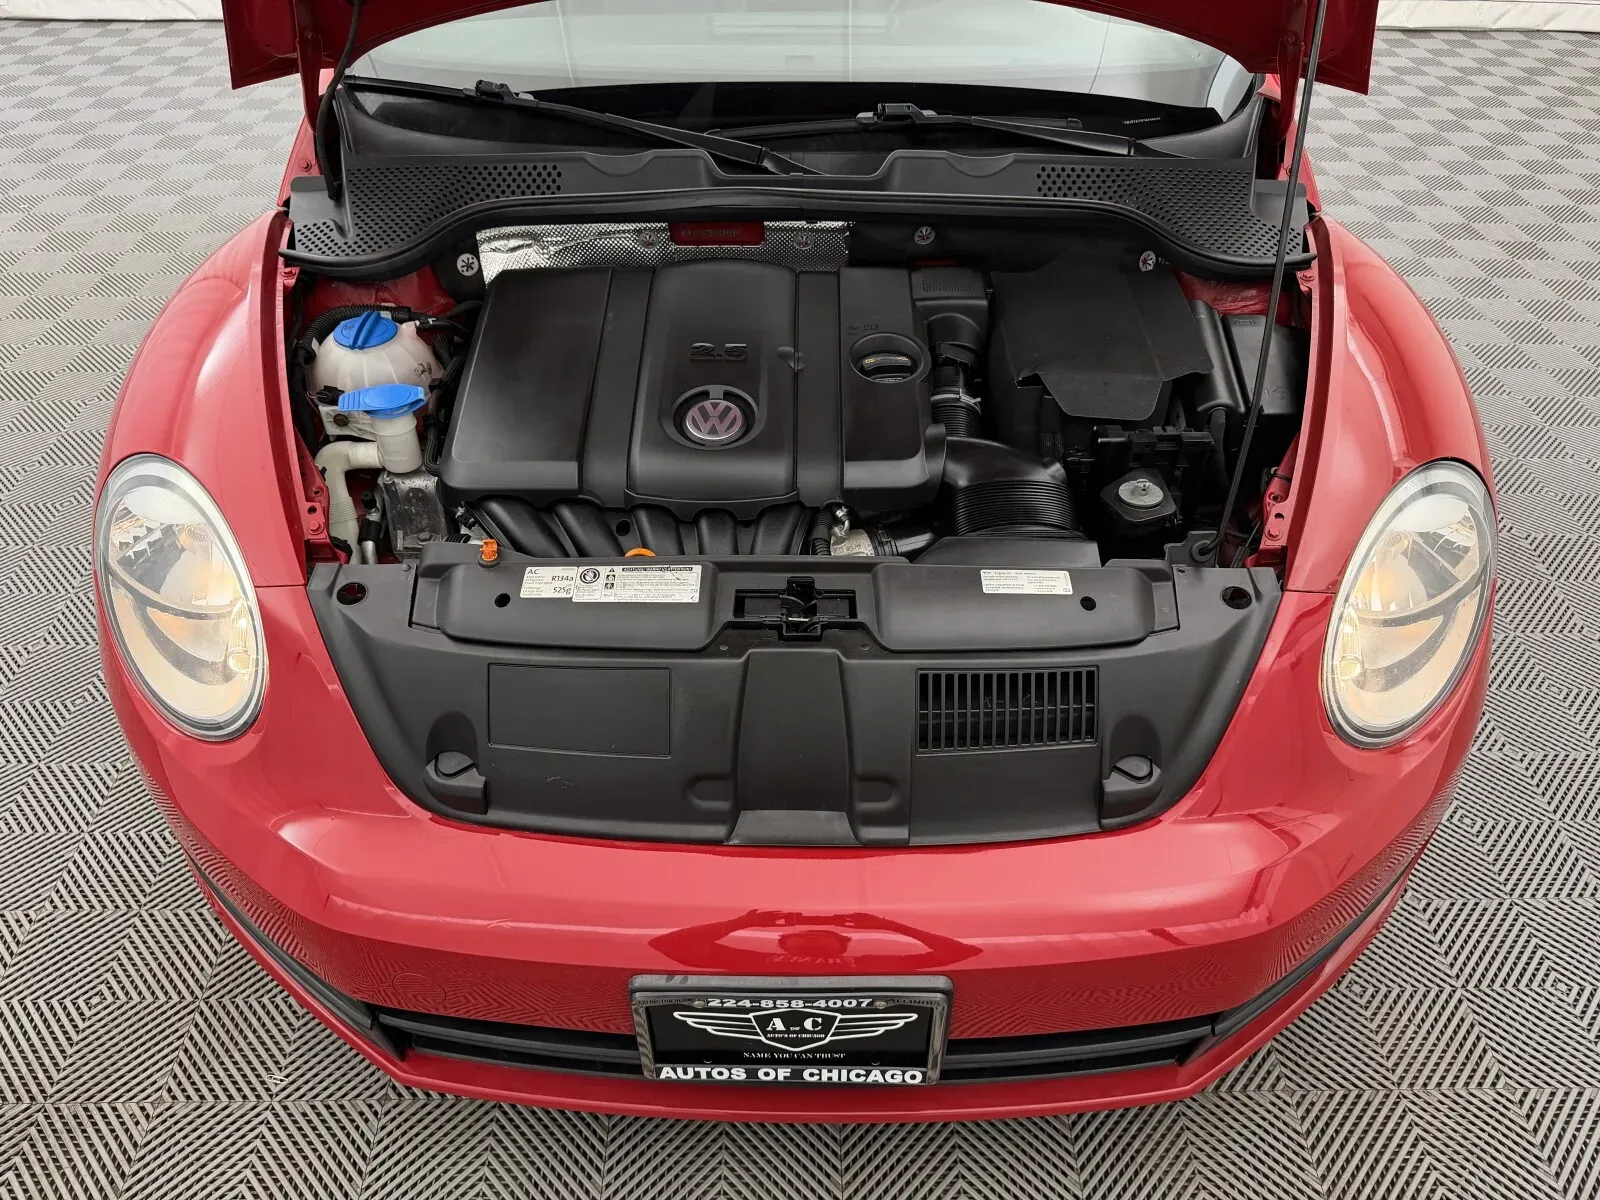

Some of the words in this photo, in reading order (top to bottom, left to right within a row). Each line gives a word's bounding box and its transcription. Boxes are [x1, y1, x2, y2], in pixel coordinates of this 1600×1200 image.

[690, 342, 748, 361] 2.5
[686, 399, 744, 439] VW
[552, 586, 572, 595] 525g
[707, 998, 873, 1008] 224-858-4007
[766, 1017, 787, 1031] A
[803, 1017, 822, 1031] C
[659, 1066, 747, 1080] AUTOS
[757, 1068, 792, 1081] OF
[802, 1068, 923, 1084] CHICAGO
